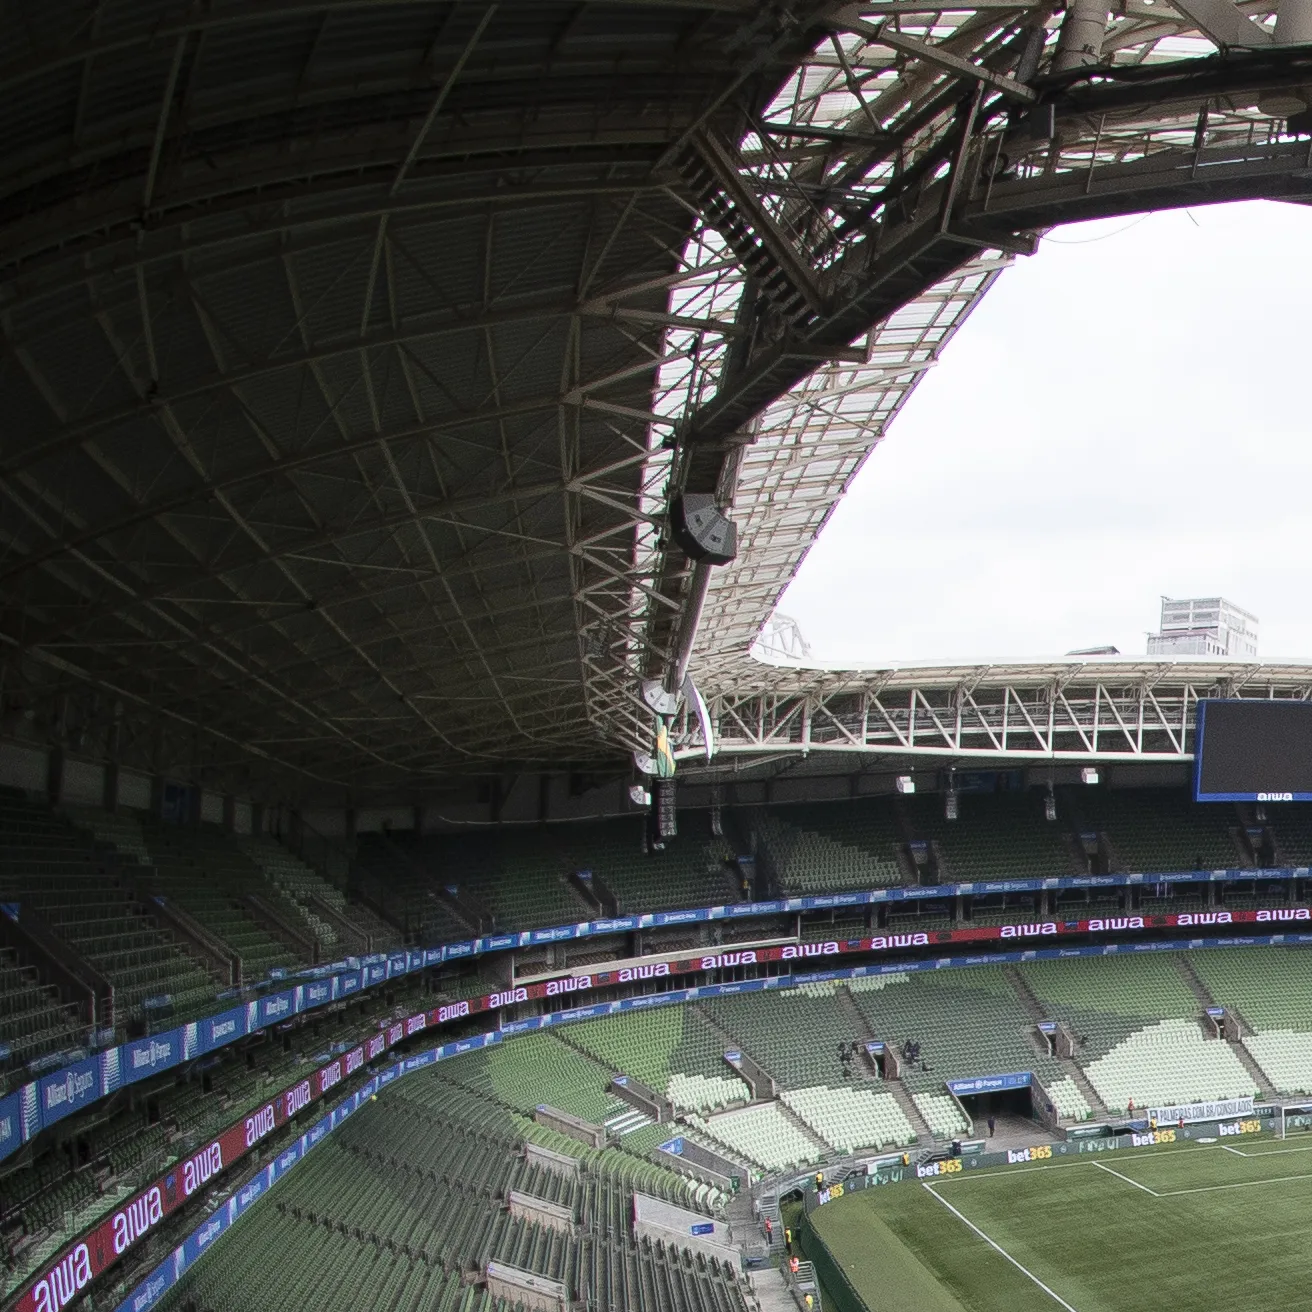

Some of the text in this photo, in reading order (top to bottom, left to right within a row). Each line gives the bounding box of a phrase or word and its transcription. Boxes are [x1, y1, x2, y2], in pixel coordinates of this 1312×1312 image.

[1257, 792, 1293, 801] aiwa
[1089, 916, 1144, 931] aiwa
[1178, 912, 1232, 925] aiwa
[1256, 909, 1310, 921] aiwa
[1000, 923, 1057, 938] aiwa
[782, 942, 839, 959] aiwa
[871, 933, 929, 949] aiwa
[701, 951, 757, 969] aiwa
[618, 963, 670, 981] aiwa
[546, 974, 592, 995] aiwa
[489, 987, 529, 1007] aiwa
[439, 1001, 470, 1021] aiwa
[321, 1061, 341, 1091] aiwa
[286, 1080, 311, 1116] aiwa
[246, 1107, 275, 1147] aiwa
[1219, 1117, 1262, 1136] bet365
[1132, 1128, 1176, 1147] bet365
[1007, 1145, 1052, 1163] bet365
[184, 1142, 223, 1195] aiwa
[916, 1159, 962, 1179] bet365
[113, 1186, 164, 1254] aiwa
